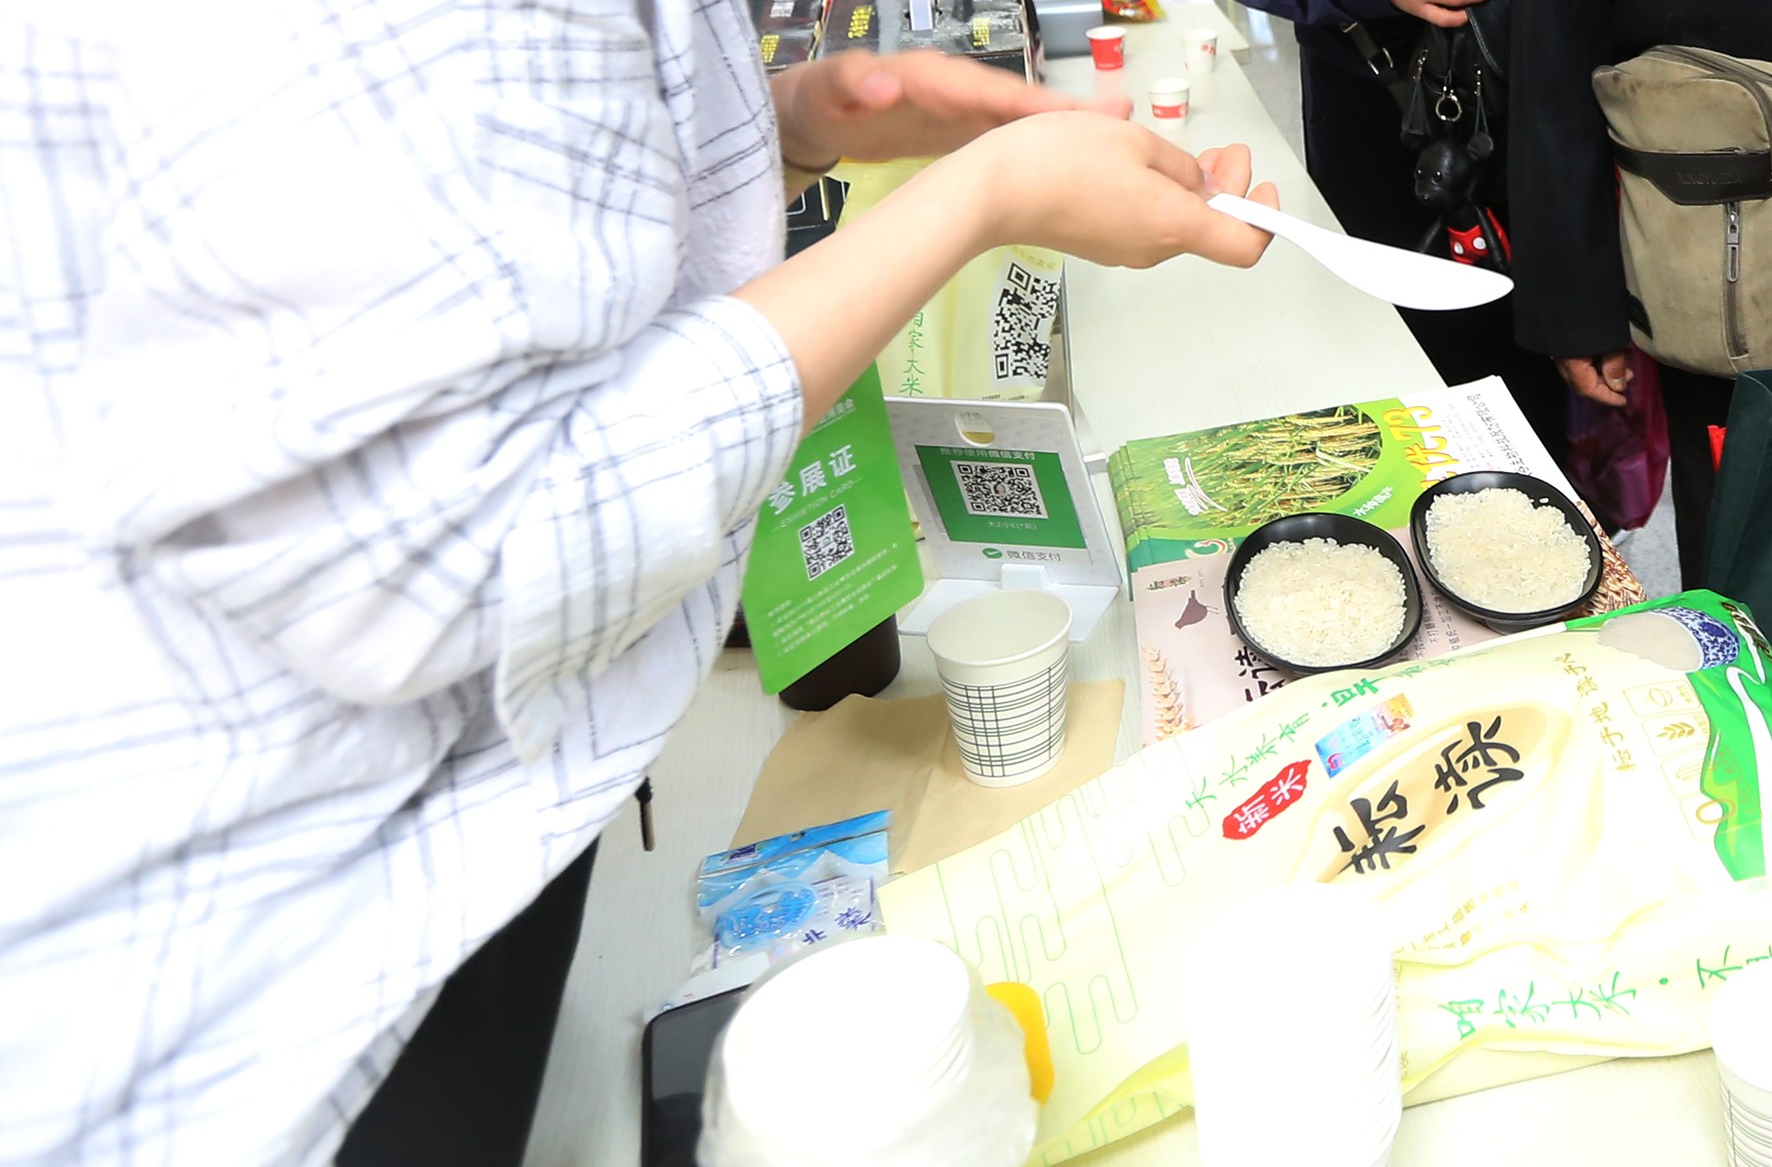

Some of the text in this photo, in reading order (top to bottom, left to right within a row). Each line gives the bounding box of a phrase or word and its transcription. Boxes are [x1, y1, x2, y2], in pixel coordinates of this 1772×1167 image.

[940, 447, 1036, 461] 推荐使用微信支付
[768, 444, 856, 516] 参展证
[1007, 549, 1061, 562] 微信支付
[1232, 767, 1303, 835] 新米
